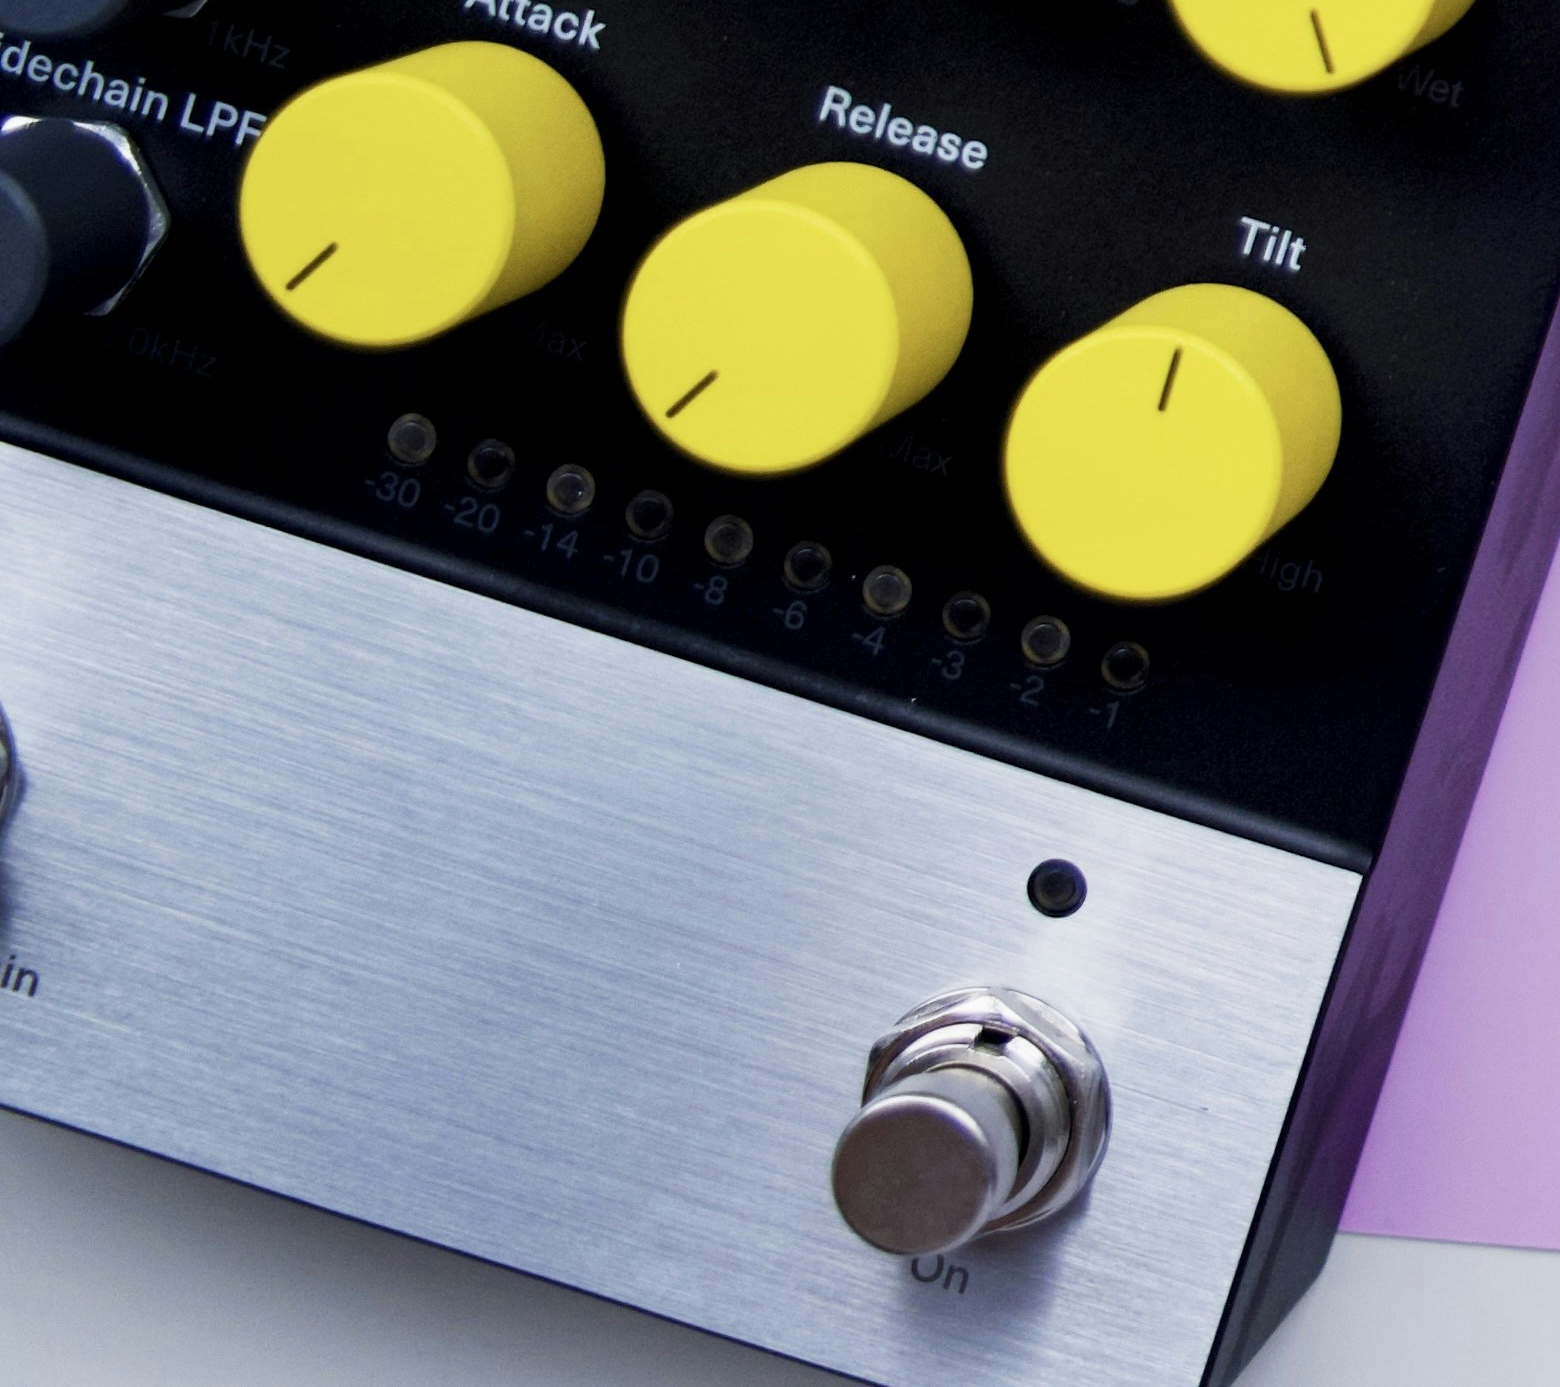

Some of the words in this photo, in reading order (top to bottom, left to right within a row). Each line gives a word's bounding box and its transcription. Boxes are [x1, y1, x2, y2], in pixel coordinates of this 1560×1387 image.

[179, 91, 268, 148] LPF
[818, 85, 988, 170] Release
[1239, 215, 1306, 272] Tilt
[364, 470, 422, 509] -30
[444, 496, 501, 535] -20
[523, 523, 579, 560] -14
[602, 548, 660, 584] -10
[693, 574, 729, 606] -8
[772, 599, 808, 631] -6
[851, 626, 886, 656] -4
[931, 649, 966, 681] -3
[1009, 674, 1045, 707] -2
